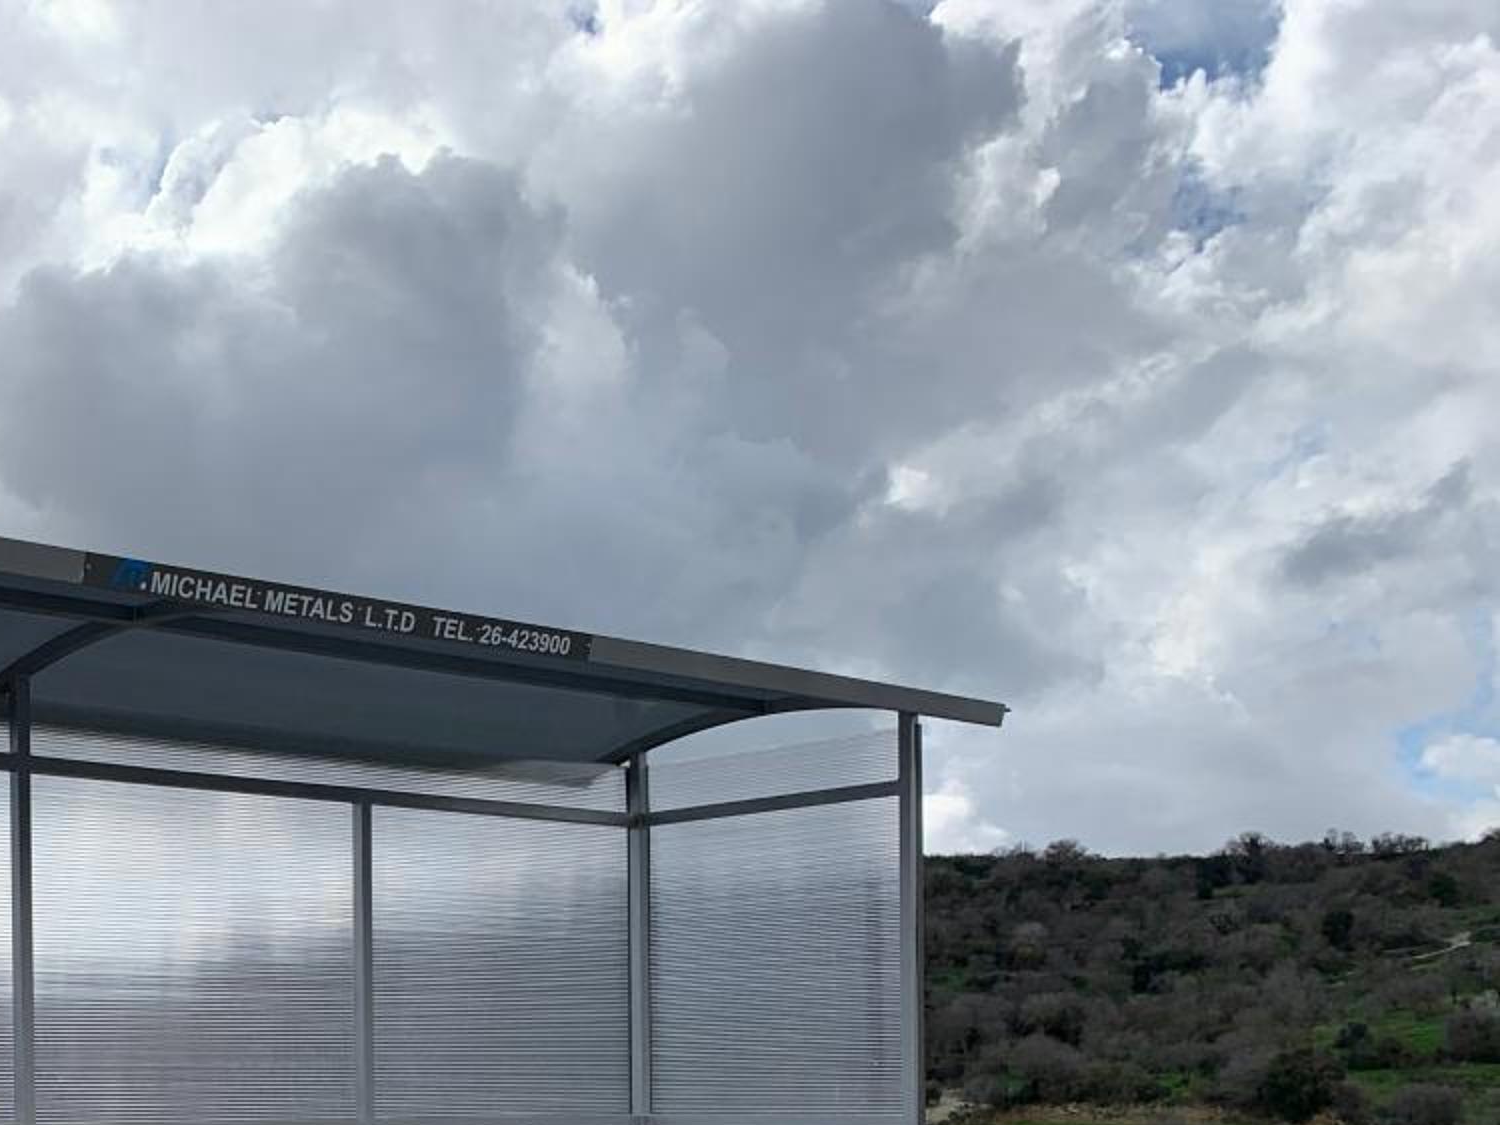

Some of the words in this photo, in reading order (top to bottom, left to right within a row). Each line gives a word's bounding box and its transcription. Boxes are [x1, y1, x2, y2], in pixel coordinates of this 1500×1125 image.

[264, 589, 353, 623] METALS
[364, 605, 415, 633] L.T.D
[432, 616, 473, 642] TEL.
[478, 624, 571, 655] 26-423900
